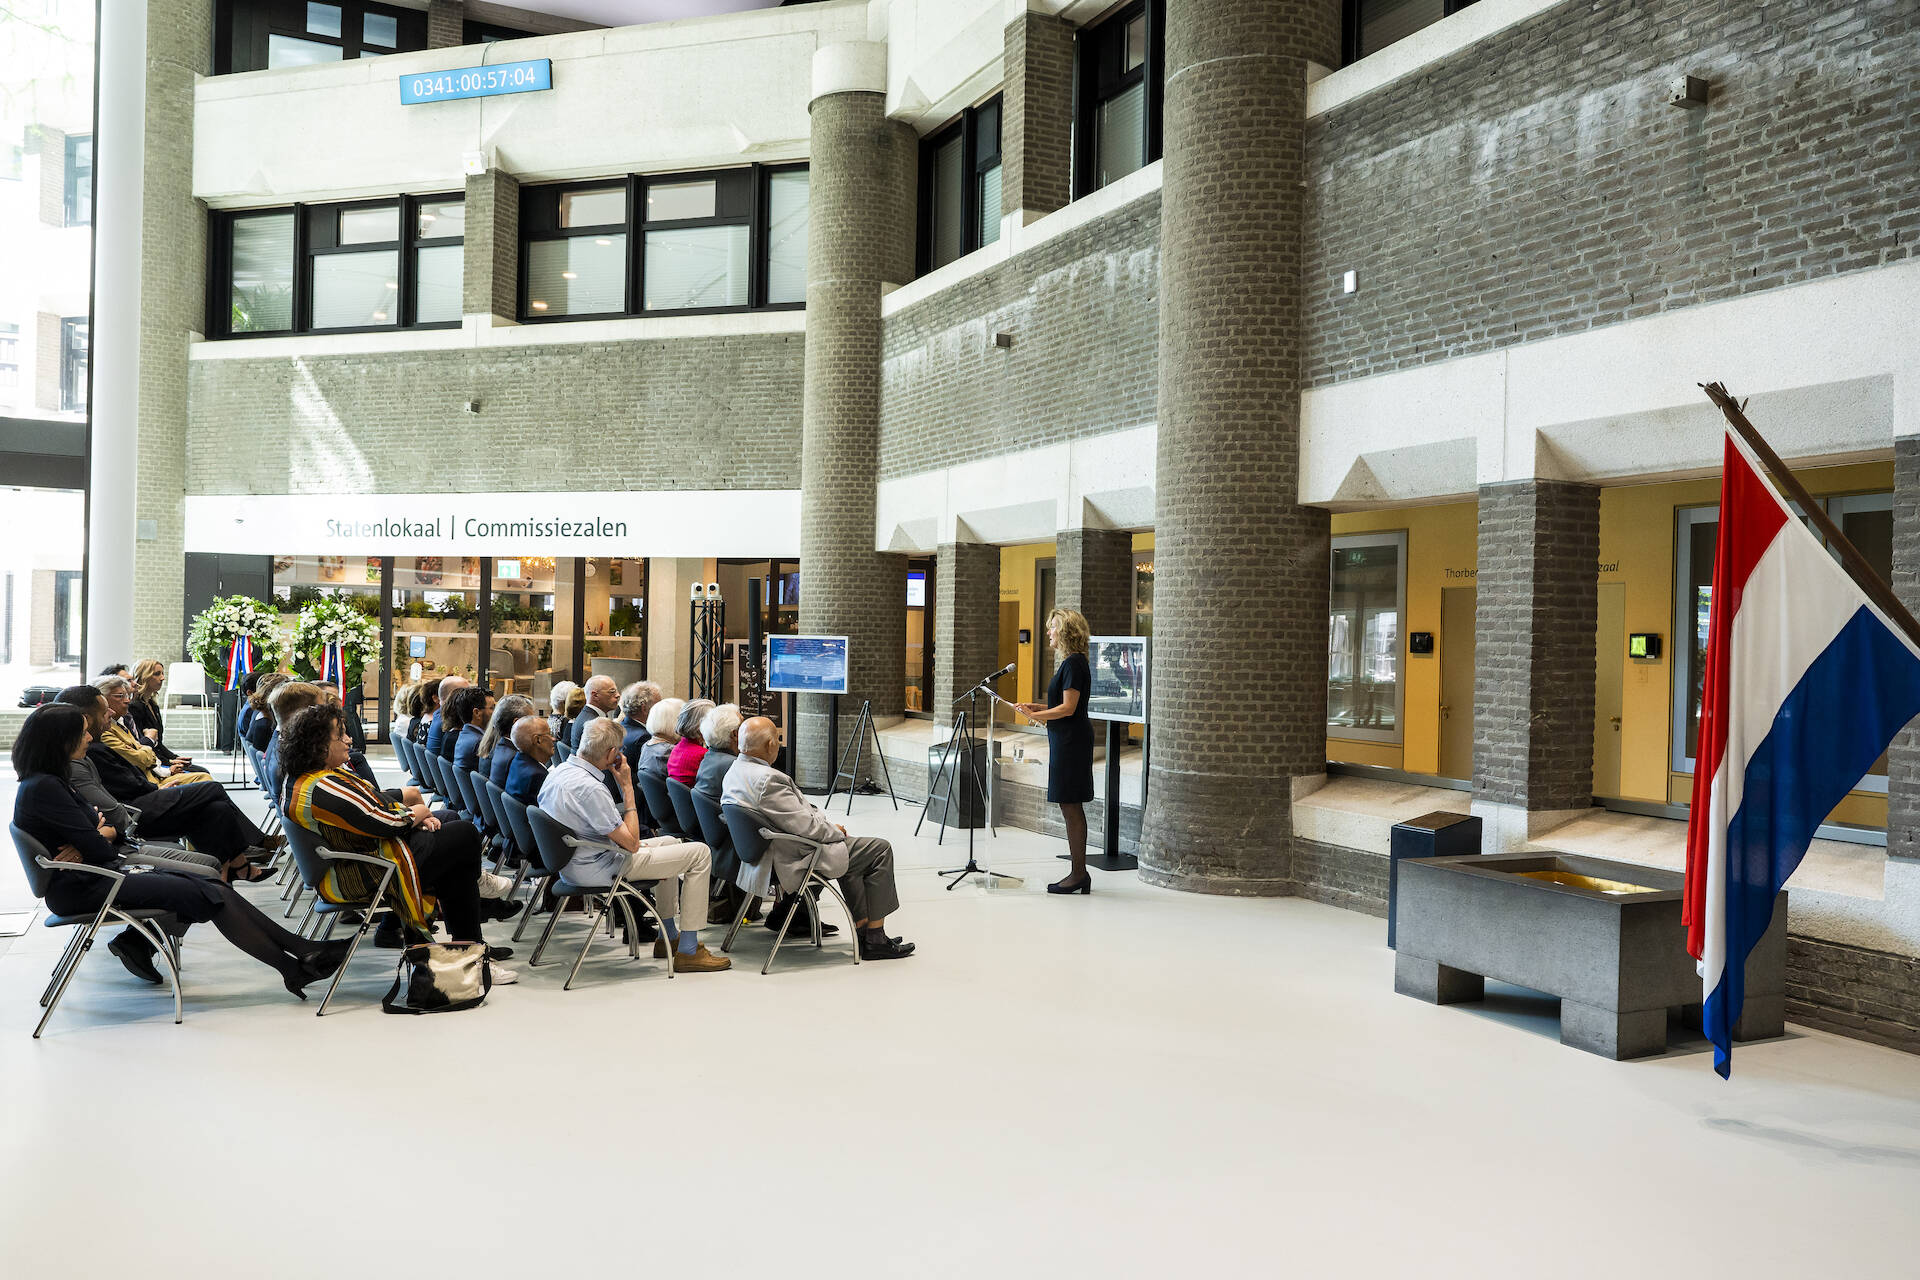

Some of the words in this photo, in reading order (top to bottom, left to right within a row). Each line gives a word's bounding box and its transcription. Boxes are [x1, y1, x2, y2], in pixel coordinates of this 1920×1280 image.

[413, 67, 536, 97] 0341:00:57:04
[326, 517, 441, 538] Statenlokaal
[464, 516, 628, 538] Commissiezalen
